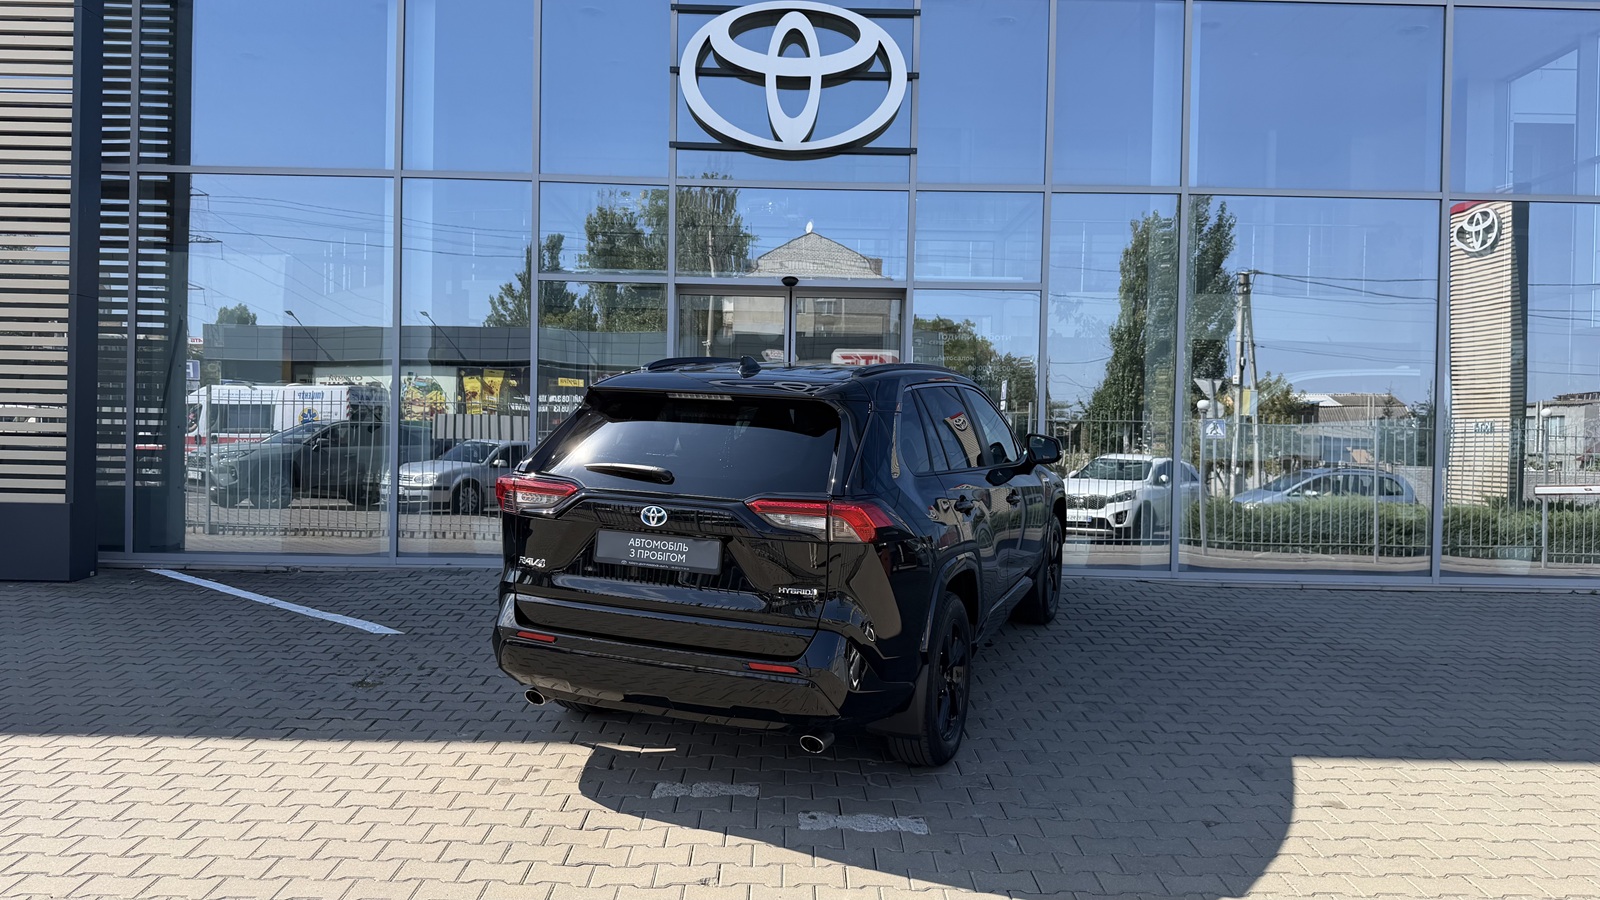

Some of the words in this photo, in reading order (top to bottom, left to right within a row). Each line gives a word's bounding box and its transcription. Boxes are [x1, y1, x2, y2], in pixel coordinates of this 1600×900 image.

[628, 537, 689, 552] АВТОМОБІЛЬ
[518, 555, 546, 568] RAV4
[637, 549, 686, 563] ПРОБІГОМ
[778, 587, 811, 595] HYBRID
